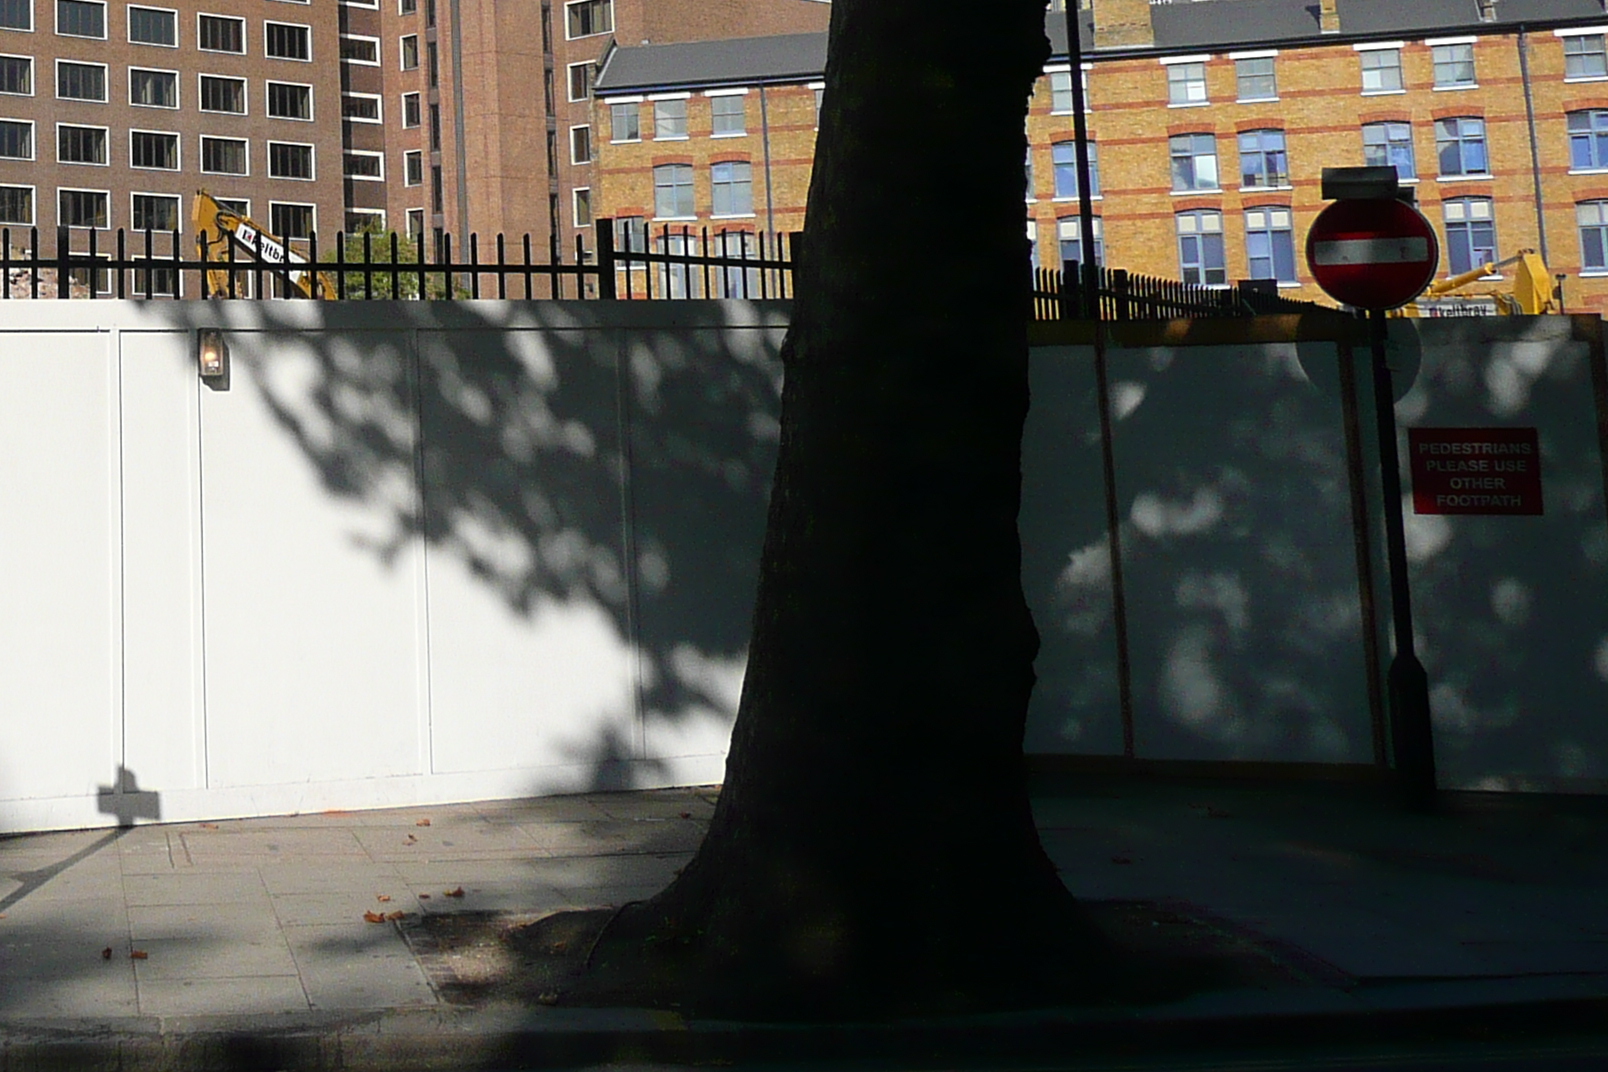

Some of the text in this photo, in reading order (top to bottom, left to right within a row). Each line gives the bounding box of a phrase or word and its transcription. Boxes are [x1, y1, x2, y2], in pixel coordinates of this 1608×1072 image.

[1418, 442, 1532, 455] PEDESTRIANS
[1426, 460, 1527, 472] PLEASE USE
[1449, 477, 1506, 489] OTHER
[1436, 494, 1521, 507] FOOTPATH
